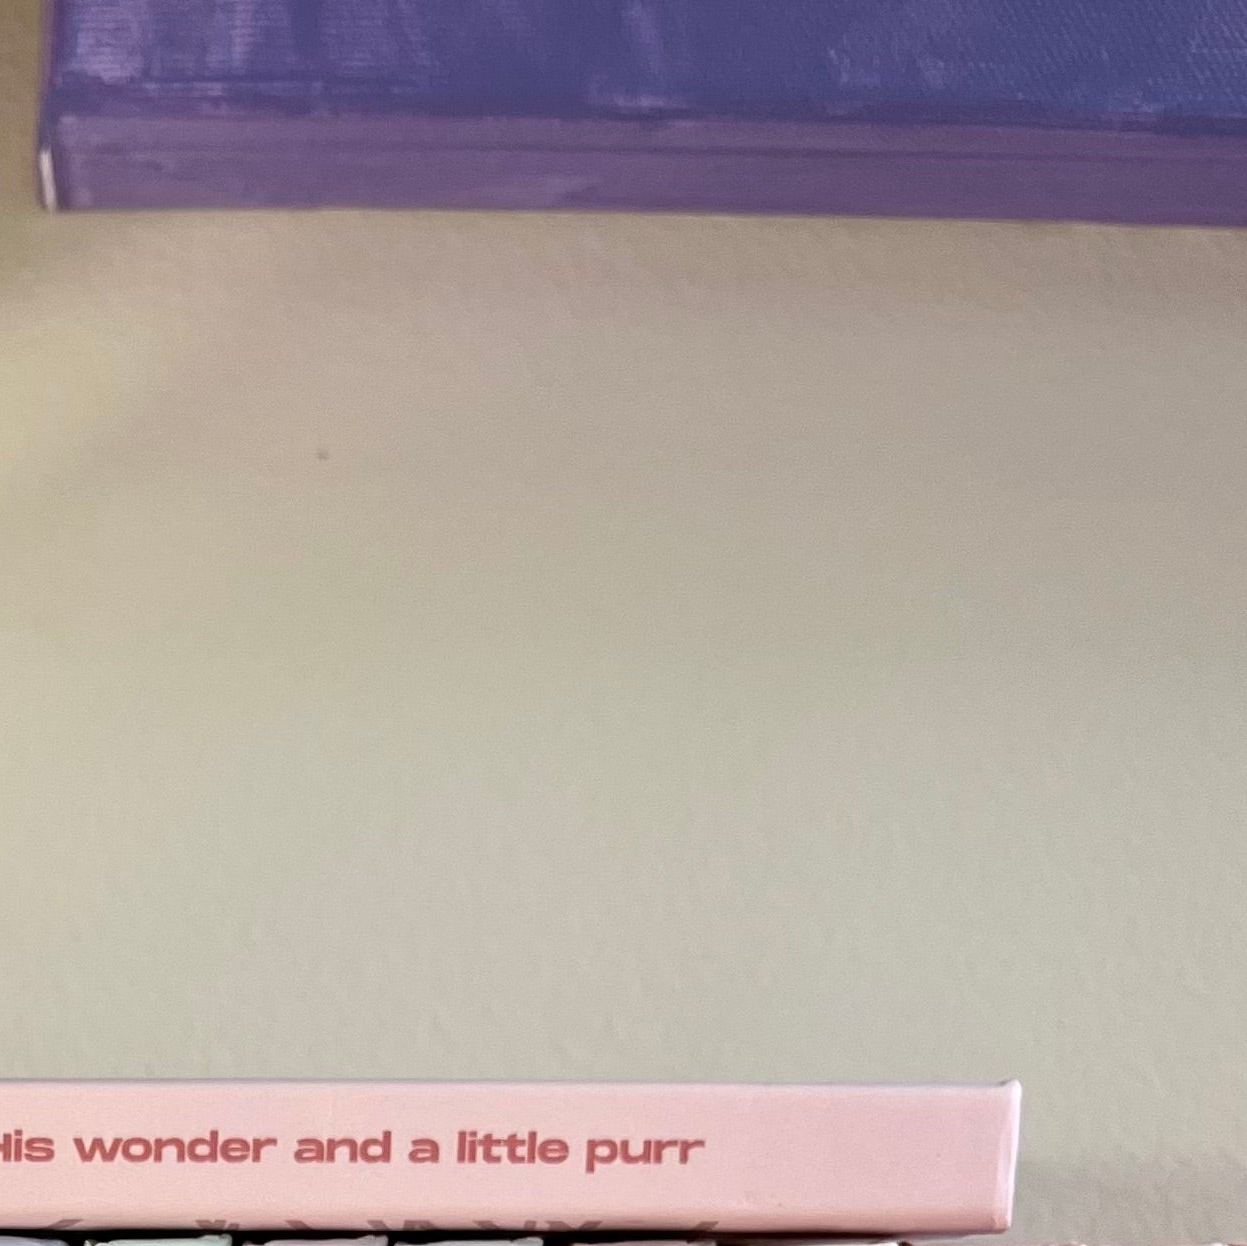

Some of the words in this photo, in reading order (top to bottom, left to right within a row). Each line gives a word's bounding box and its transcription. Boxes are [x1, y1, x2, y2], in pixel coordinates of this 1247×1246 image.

[73, 1130, 277, 1163] wonder
[294, 1130, 392, 1163] and
[408, 1138, 440, 1163] a
[457, 1130, 569, 1164] little
[586, 1139, 705, 1174] purr
